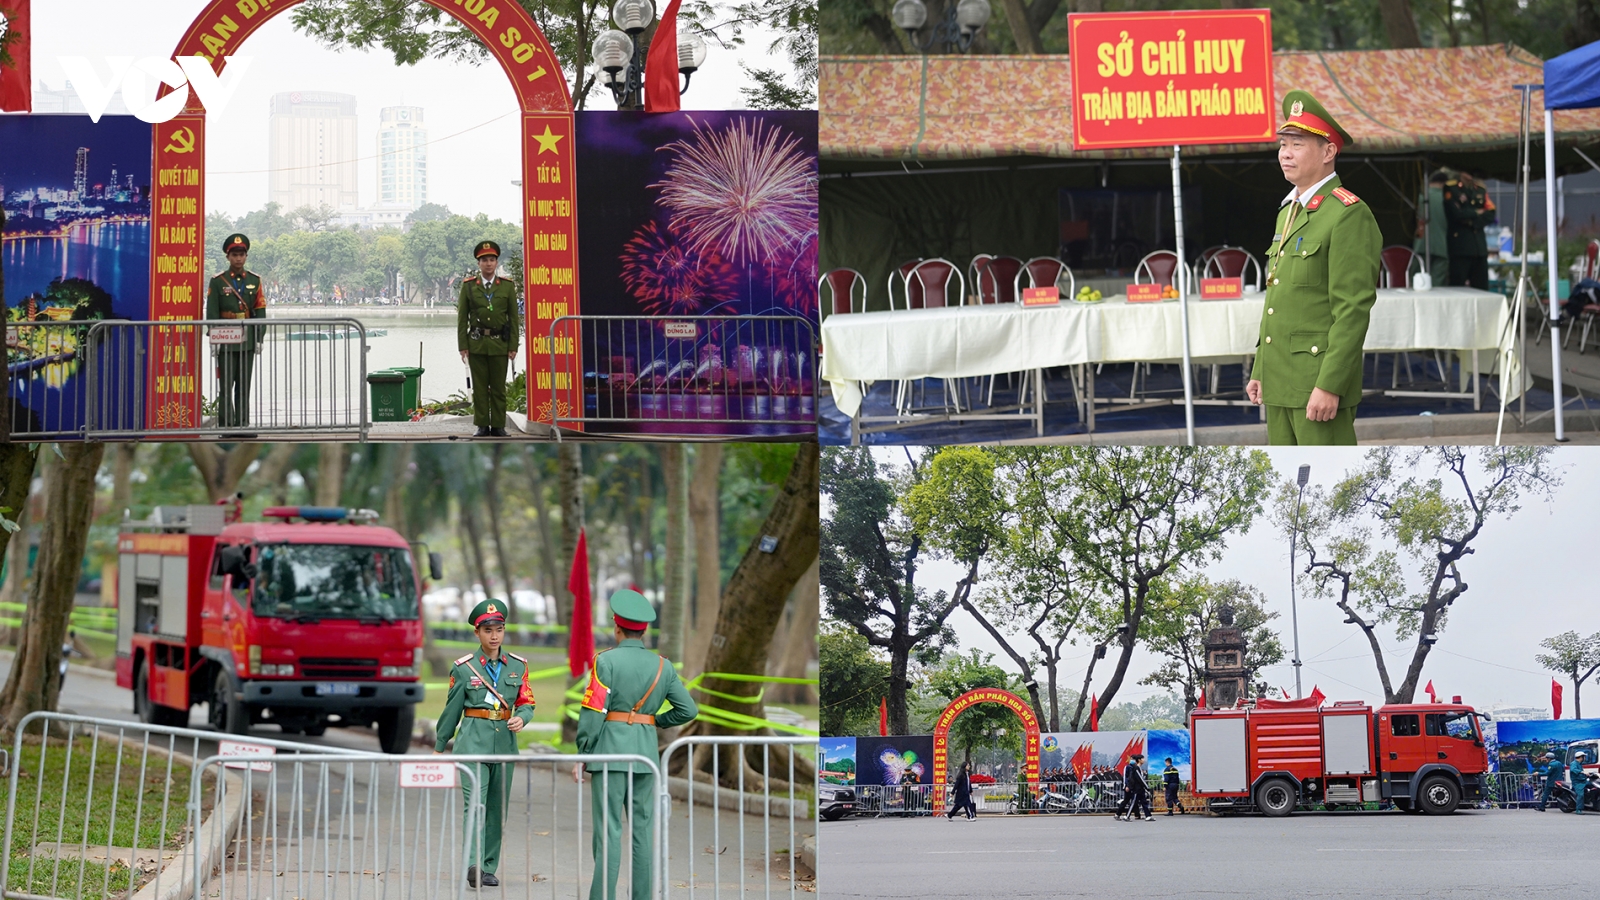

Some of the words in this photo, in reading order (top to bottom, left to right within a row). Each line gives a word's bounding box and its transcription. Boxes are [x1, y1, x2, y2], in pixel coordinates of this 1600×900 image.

[449, 0, 500, 30] OA
[499, 26, 543, 64] SỐ
[526, 65, 548, 82] 1
[1097, 30, 1134, 78] SỞ
[1141, 29, 1187, 76] CHỈ
[1194, 38, 1246, 75] HUY
[1081, 86, 1124, 126] TRẬN
[1125, 90, 1154, 125] ĐỊA
[1155, 79, 1188, 118] BẮN
[1190, 83, 1232, 117] PHÁO
[1233, 87, 1265, 115] HOA
[159, 163, 182, 188] QUYẾT
[183, 165, 199, 186] TÂM
[537, 161, 550, 183] TẤT
[550, 161, 561, 183] CẢ
[160, 194, 175, 215] XÂY
[176, 196, 197, 219] DỰNG
[529, 196, 537, 217] VÌ
[537, 200, 554, 221] MỤC
[554, 196, 571, 217] TIÊU
[159, 223, 170, 244] VÀ
[170, 221, 186, 244] BẢO
[187, 223, 197, 248] VỆ
[534, 230, 549, 251] DÂN
[550, 230, 567, 251] GIÀU
[157, 253, 177, 273] VỮNG
[177, 250, 198, 273] CHẮC
[530, 264, 550, 285] NƯỚC
[551, 267, 573, 289] MẠNH
[161, 279, 172, 303] TỔ
[172, 279, 192, 305] QUỐC
[537, 298, 552, 319] DÂN
[553, 296, 568, 320] CHỦ
[175, 315, 193, 334] NAM
[536, 368, 552, 390] VĂN
[1008, 698, 1023, 712] HOA
[411, 773, 444, 783] STOP
